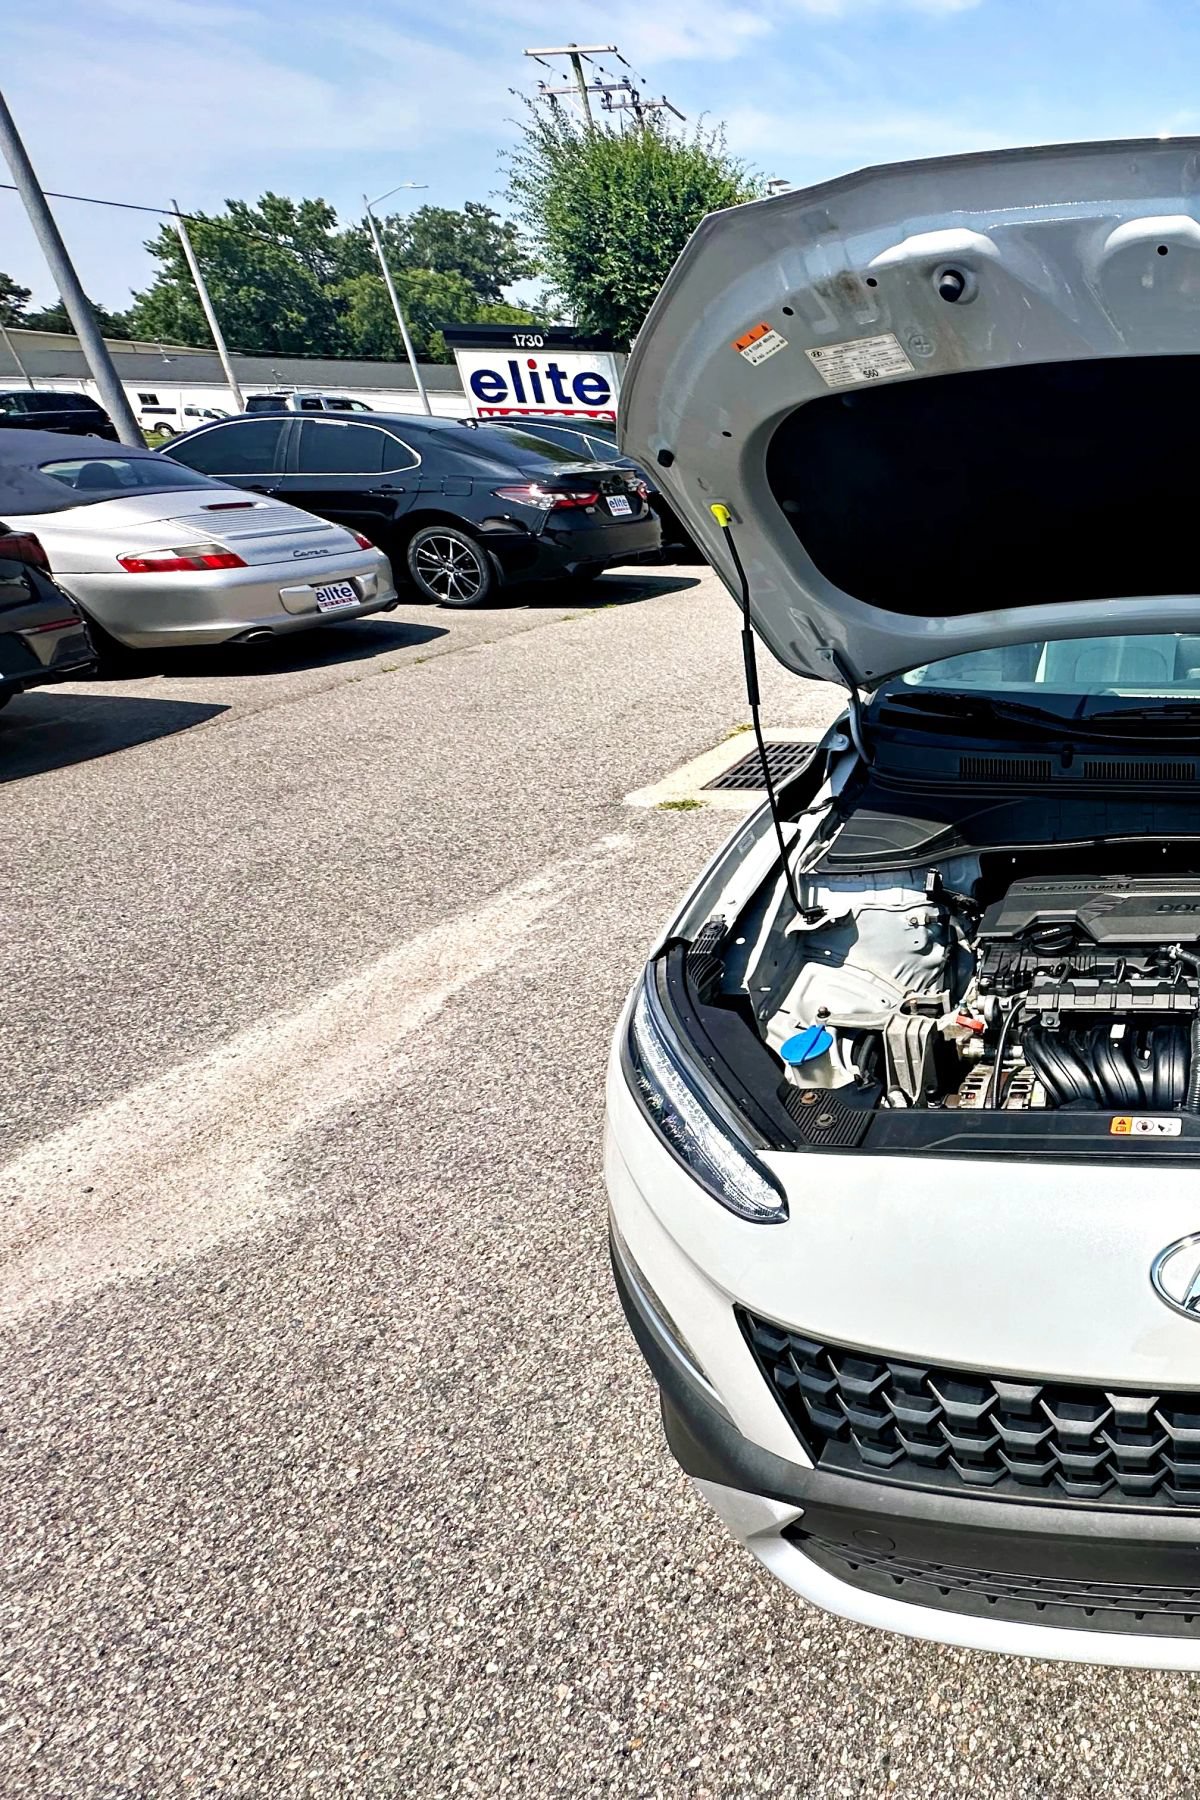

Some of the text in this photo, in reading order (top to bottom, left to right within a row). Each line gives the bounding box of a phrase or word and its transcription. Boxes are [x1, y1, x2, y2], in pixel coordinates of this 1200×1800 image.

[512, 334, 544, 347] 1730
[470, 359, 612, 406] elite
[609, 497, 628, 509] elite
[293, 549, 329, 557] Carrera
[316, 586, 353, 602] elite
